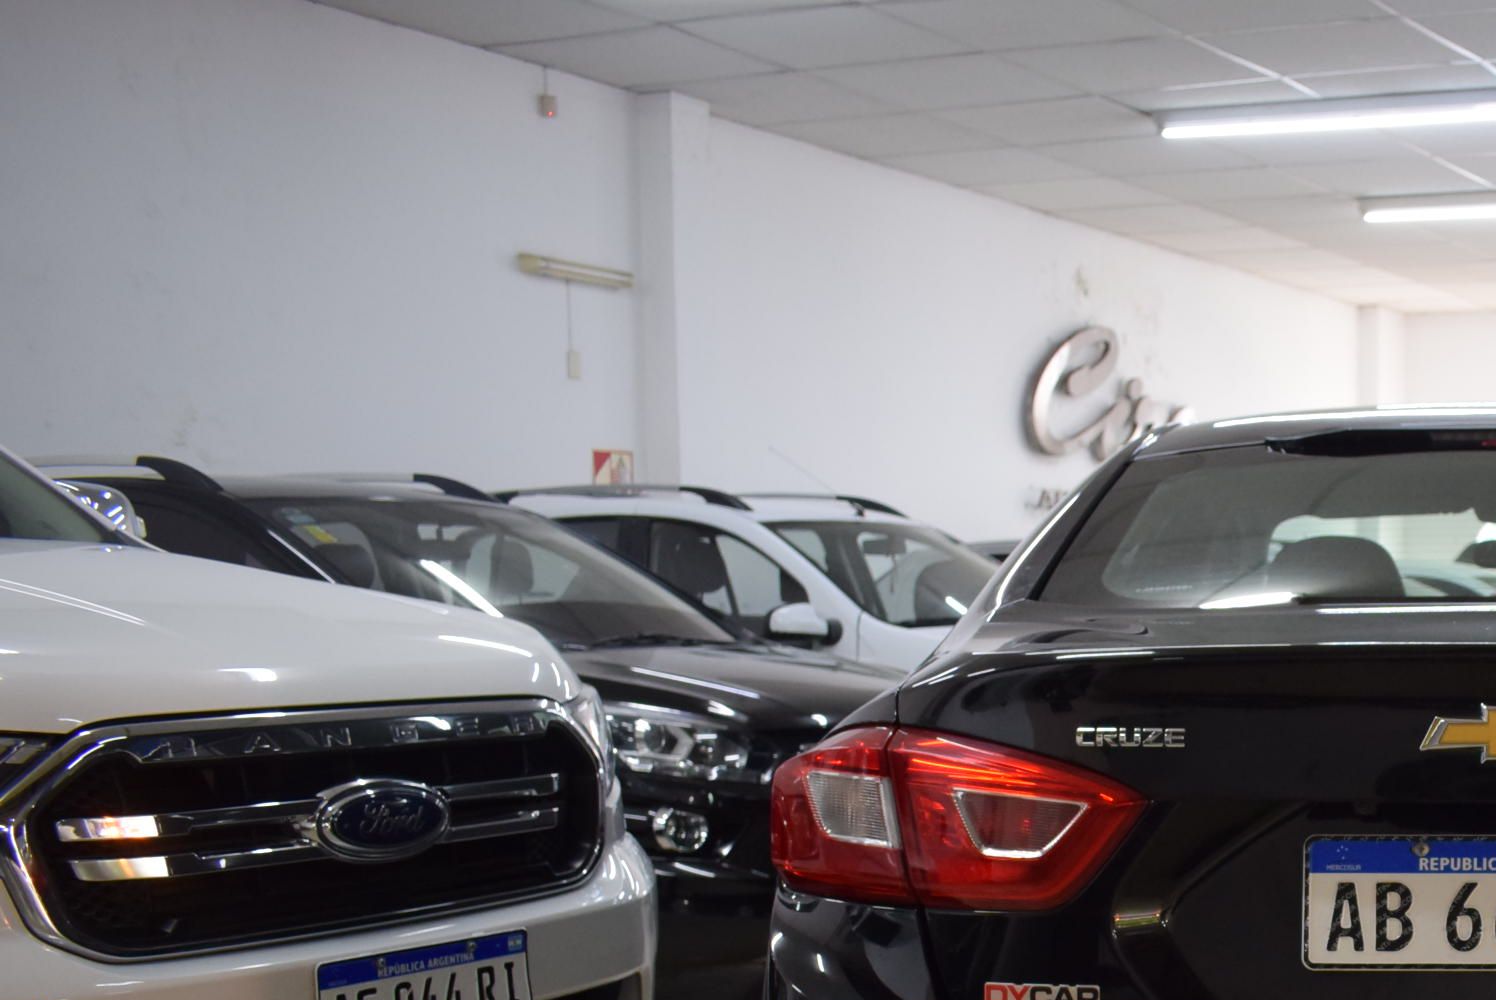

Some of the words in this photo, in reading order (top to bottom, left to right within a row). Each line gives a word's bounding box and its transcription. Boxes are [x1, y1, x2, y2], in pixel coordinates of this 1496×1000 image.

[1075, 726, 1186, 748] CRUZE
[359, 803, 425, 834] Ford
[1326, 881, 1415, 953] AB
[427, 952, 476, 969] ARGENTINA
